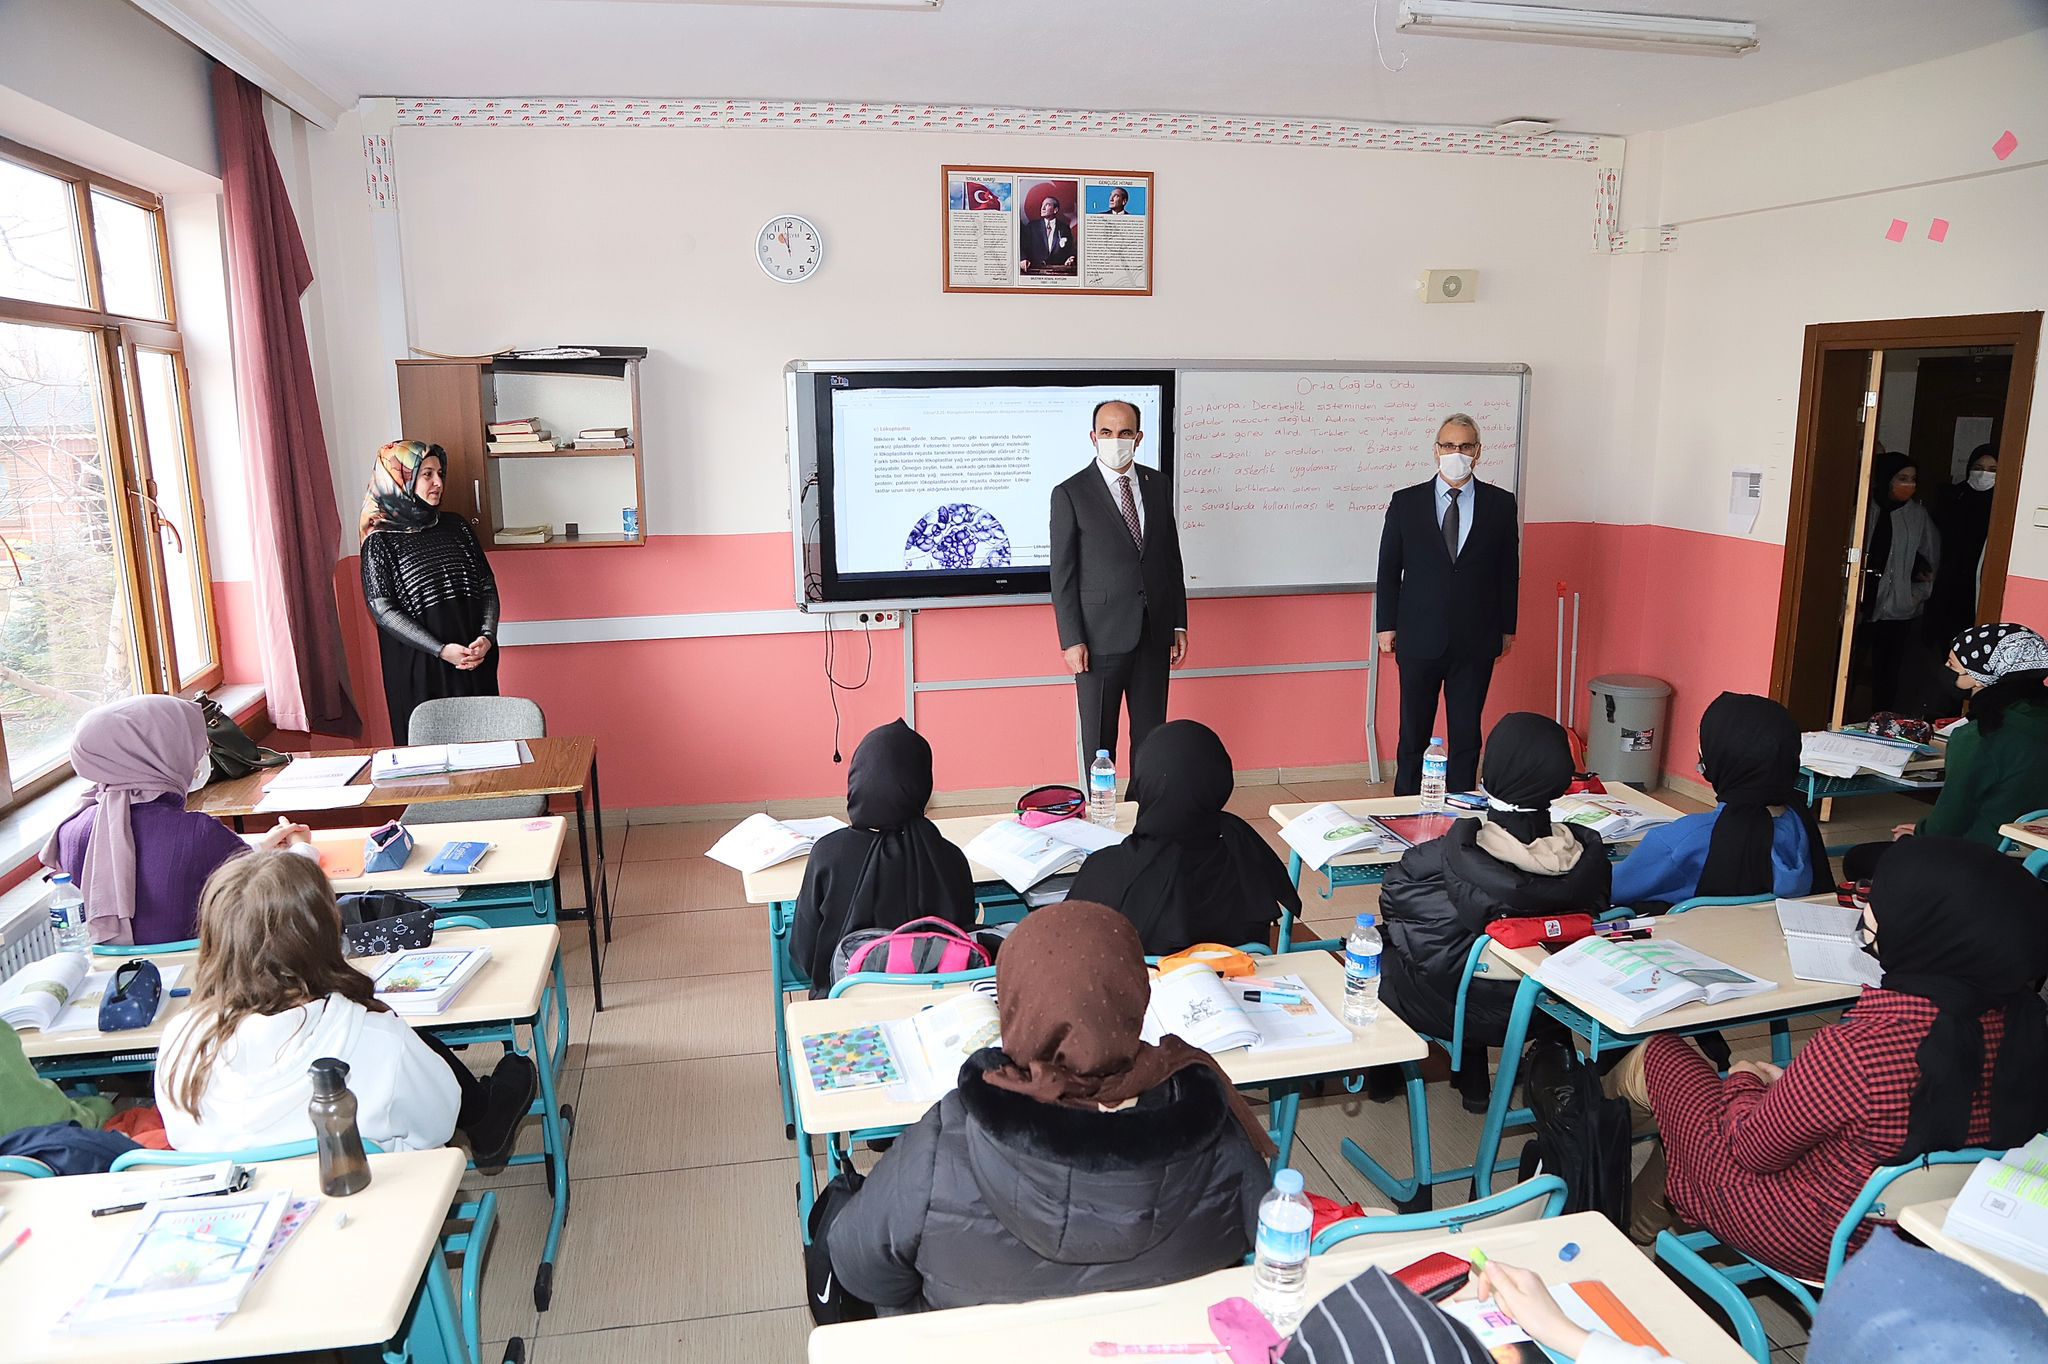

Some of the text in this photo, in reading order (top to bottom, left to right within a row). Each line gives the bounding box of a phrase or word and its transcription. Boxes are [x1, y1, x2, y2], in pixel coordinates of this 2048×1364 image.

[784, 221, 792, 229] 12
[810, 245, 816, 253] 3
[786, 268, 793, 276] 6
[799, 265, 805, 273] 5
